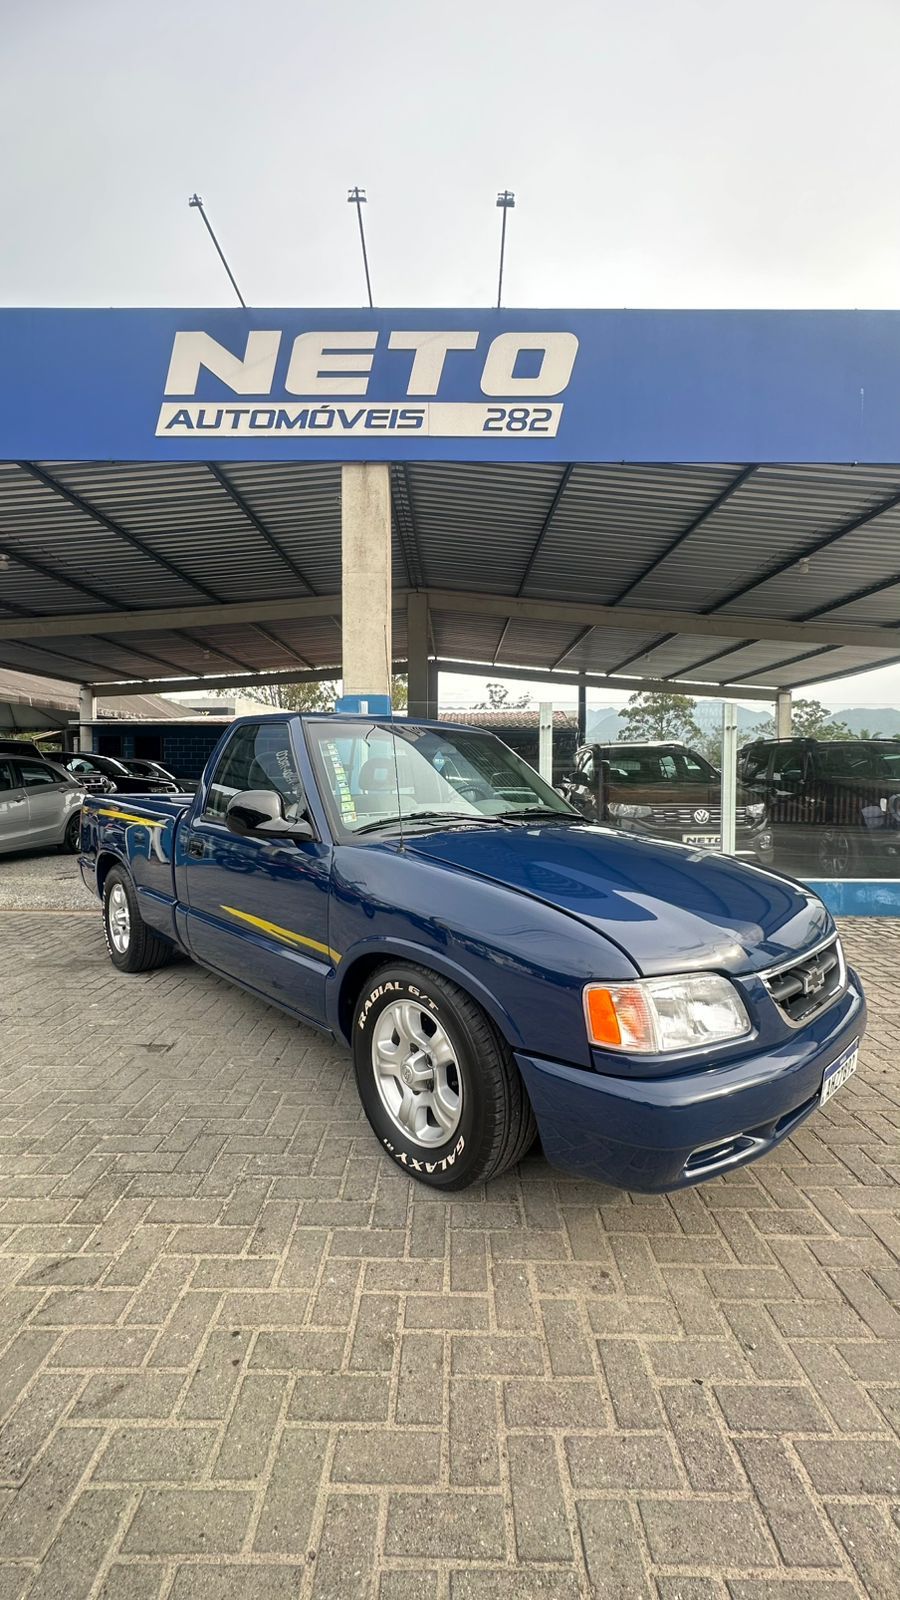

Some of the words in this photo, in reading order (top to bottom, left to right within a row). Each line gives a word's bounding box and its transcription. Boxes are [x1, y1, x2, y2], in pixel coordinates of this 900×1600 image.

[164, 330, 579, 396] NETO
[165, 405, 426, 429] AUTOMÓVEIS
[482, 407, 553, 431] 282
[358, 981, 404, 1030] RADIAL
[408, 984, 439, 1011] G/T
[395, 1135, 465, 1173] GALAXY
